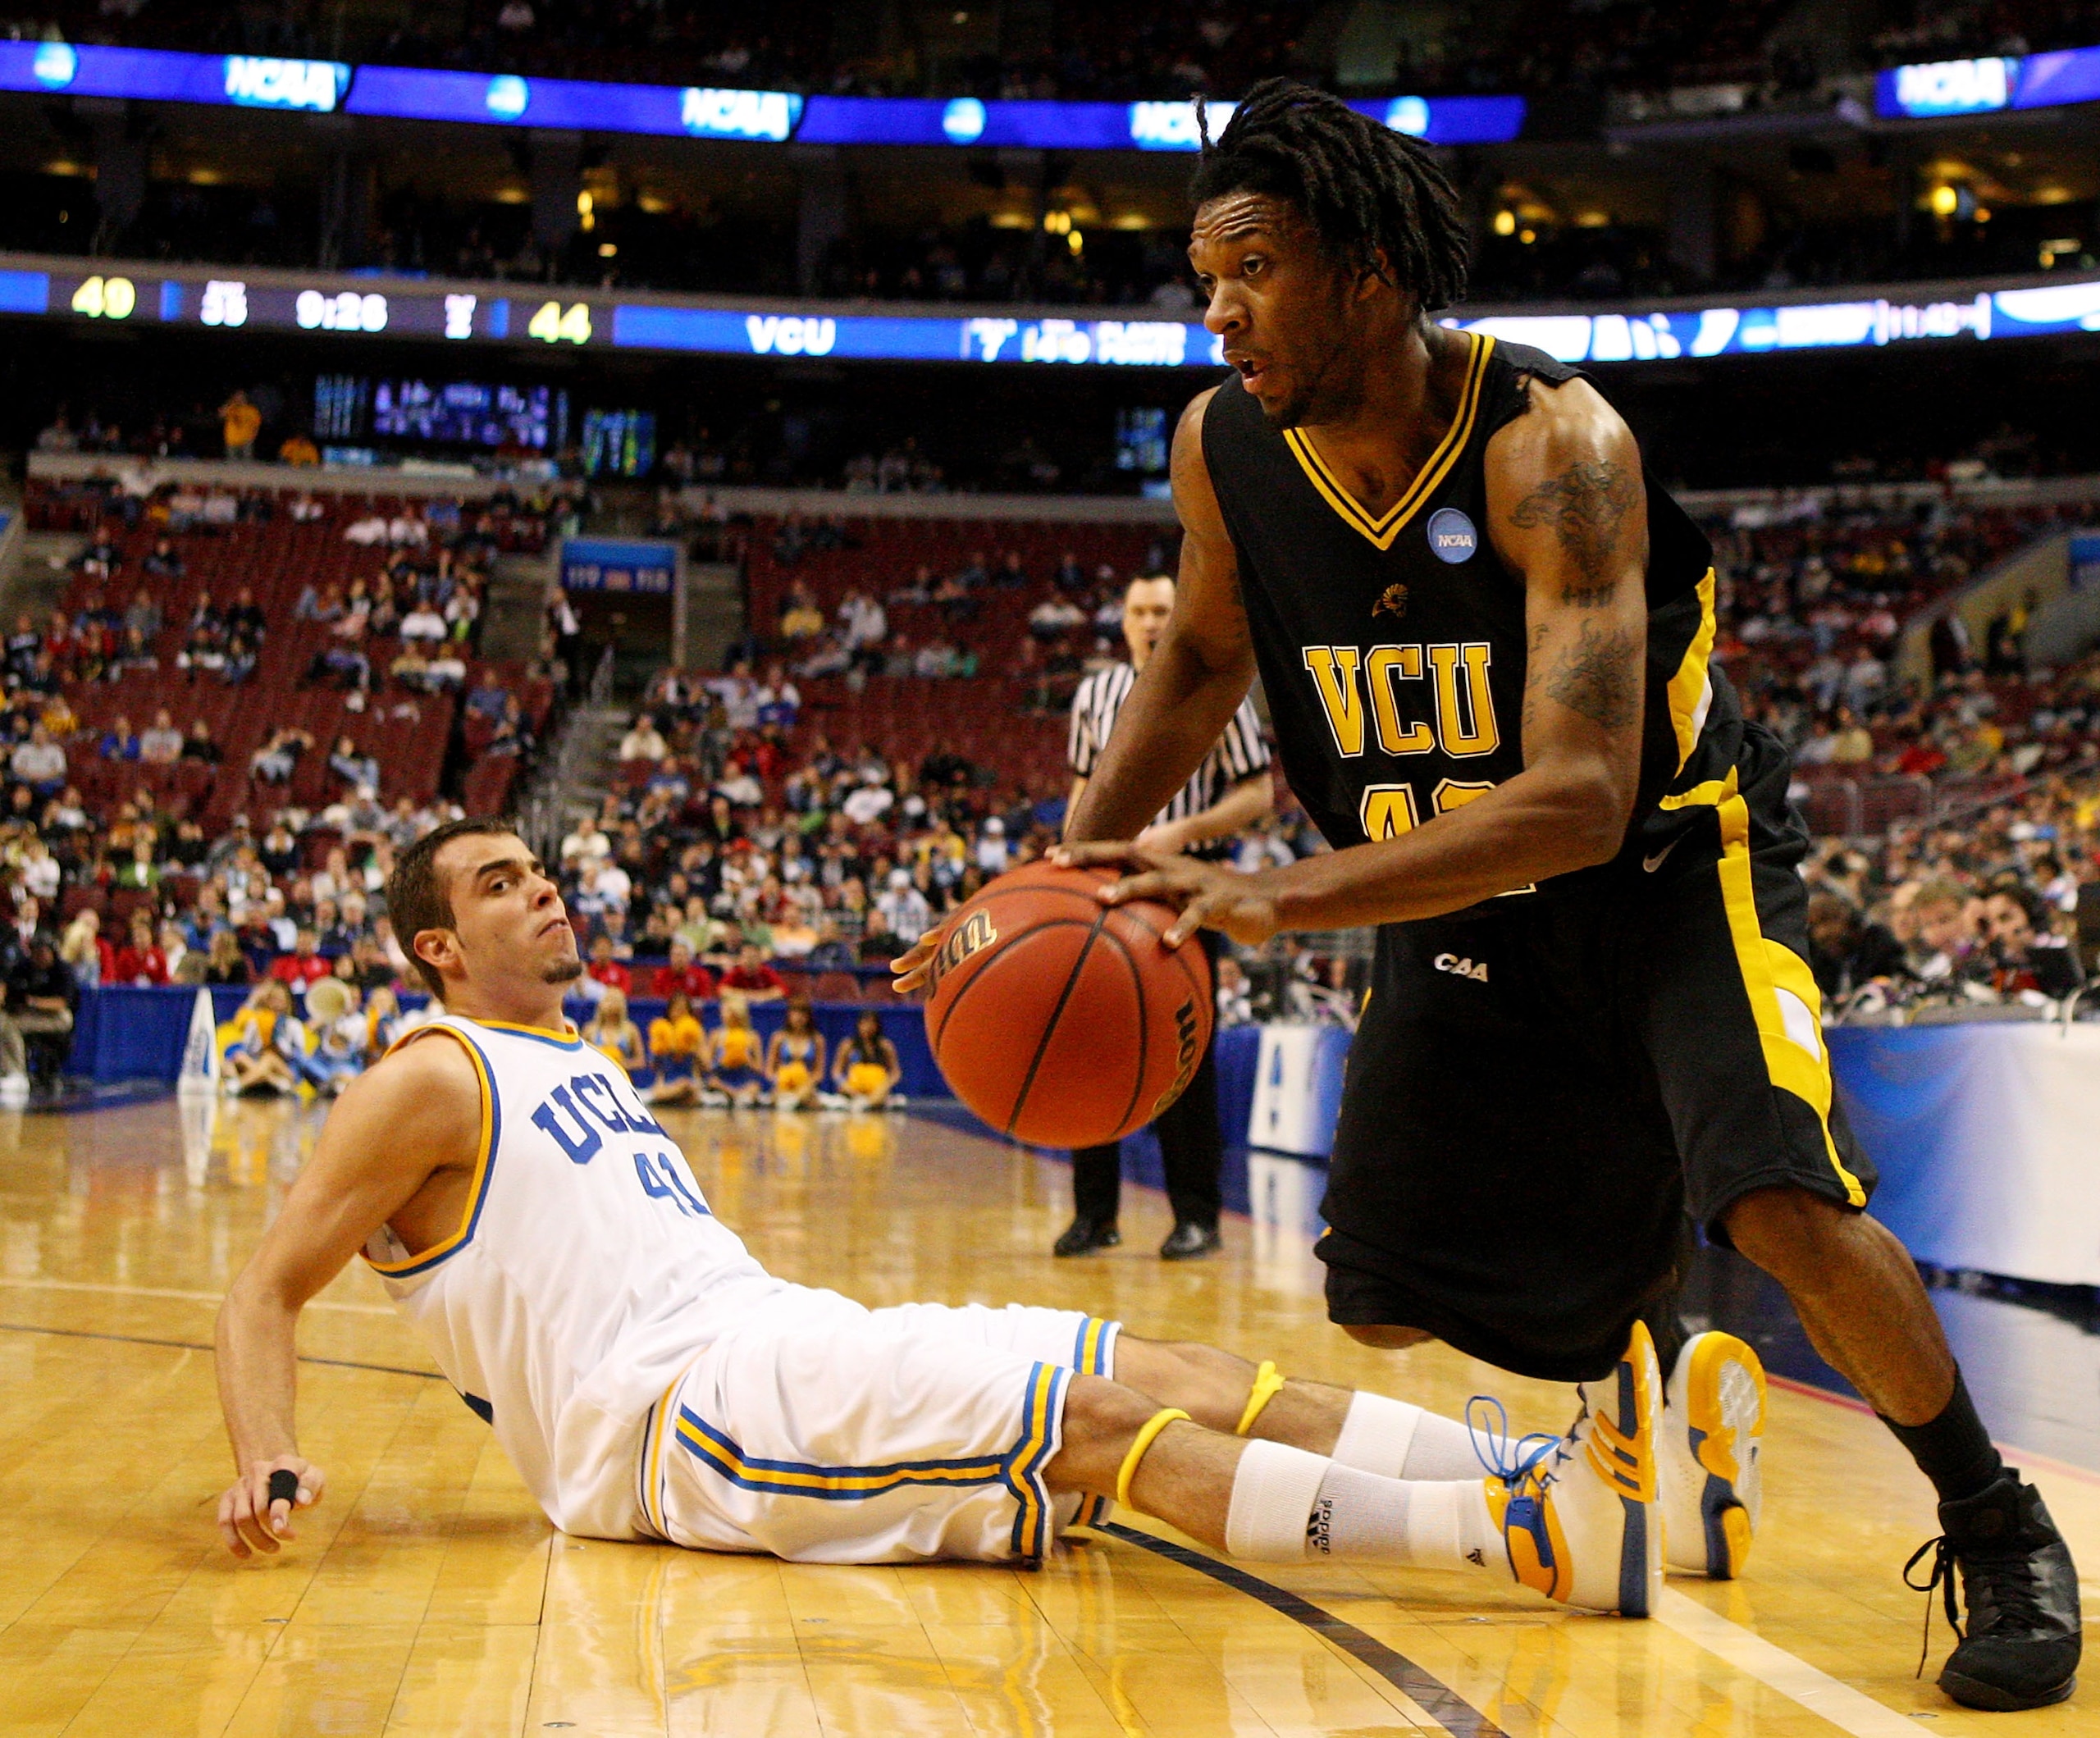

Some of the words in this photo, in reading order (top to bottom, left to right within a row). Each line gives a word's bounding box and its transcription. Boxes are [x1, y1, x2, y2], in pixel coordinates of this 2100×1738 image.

[226, 54, 336, 112] NCAA
[528, 301, 591, 344] 44
[745, 315, 837, 356] VCU
[1438, 534, 1473, 548] NCAA
[1302, 642, 1500, 759] VCU
[1434, 953, 1488, 983] CAA
[531, 1073, 673, 1165] UCL
[633, 1152, 713, 1219] 41
[1319, 1500, 1333, 1555] adidas
